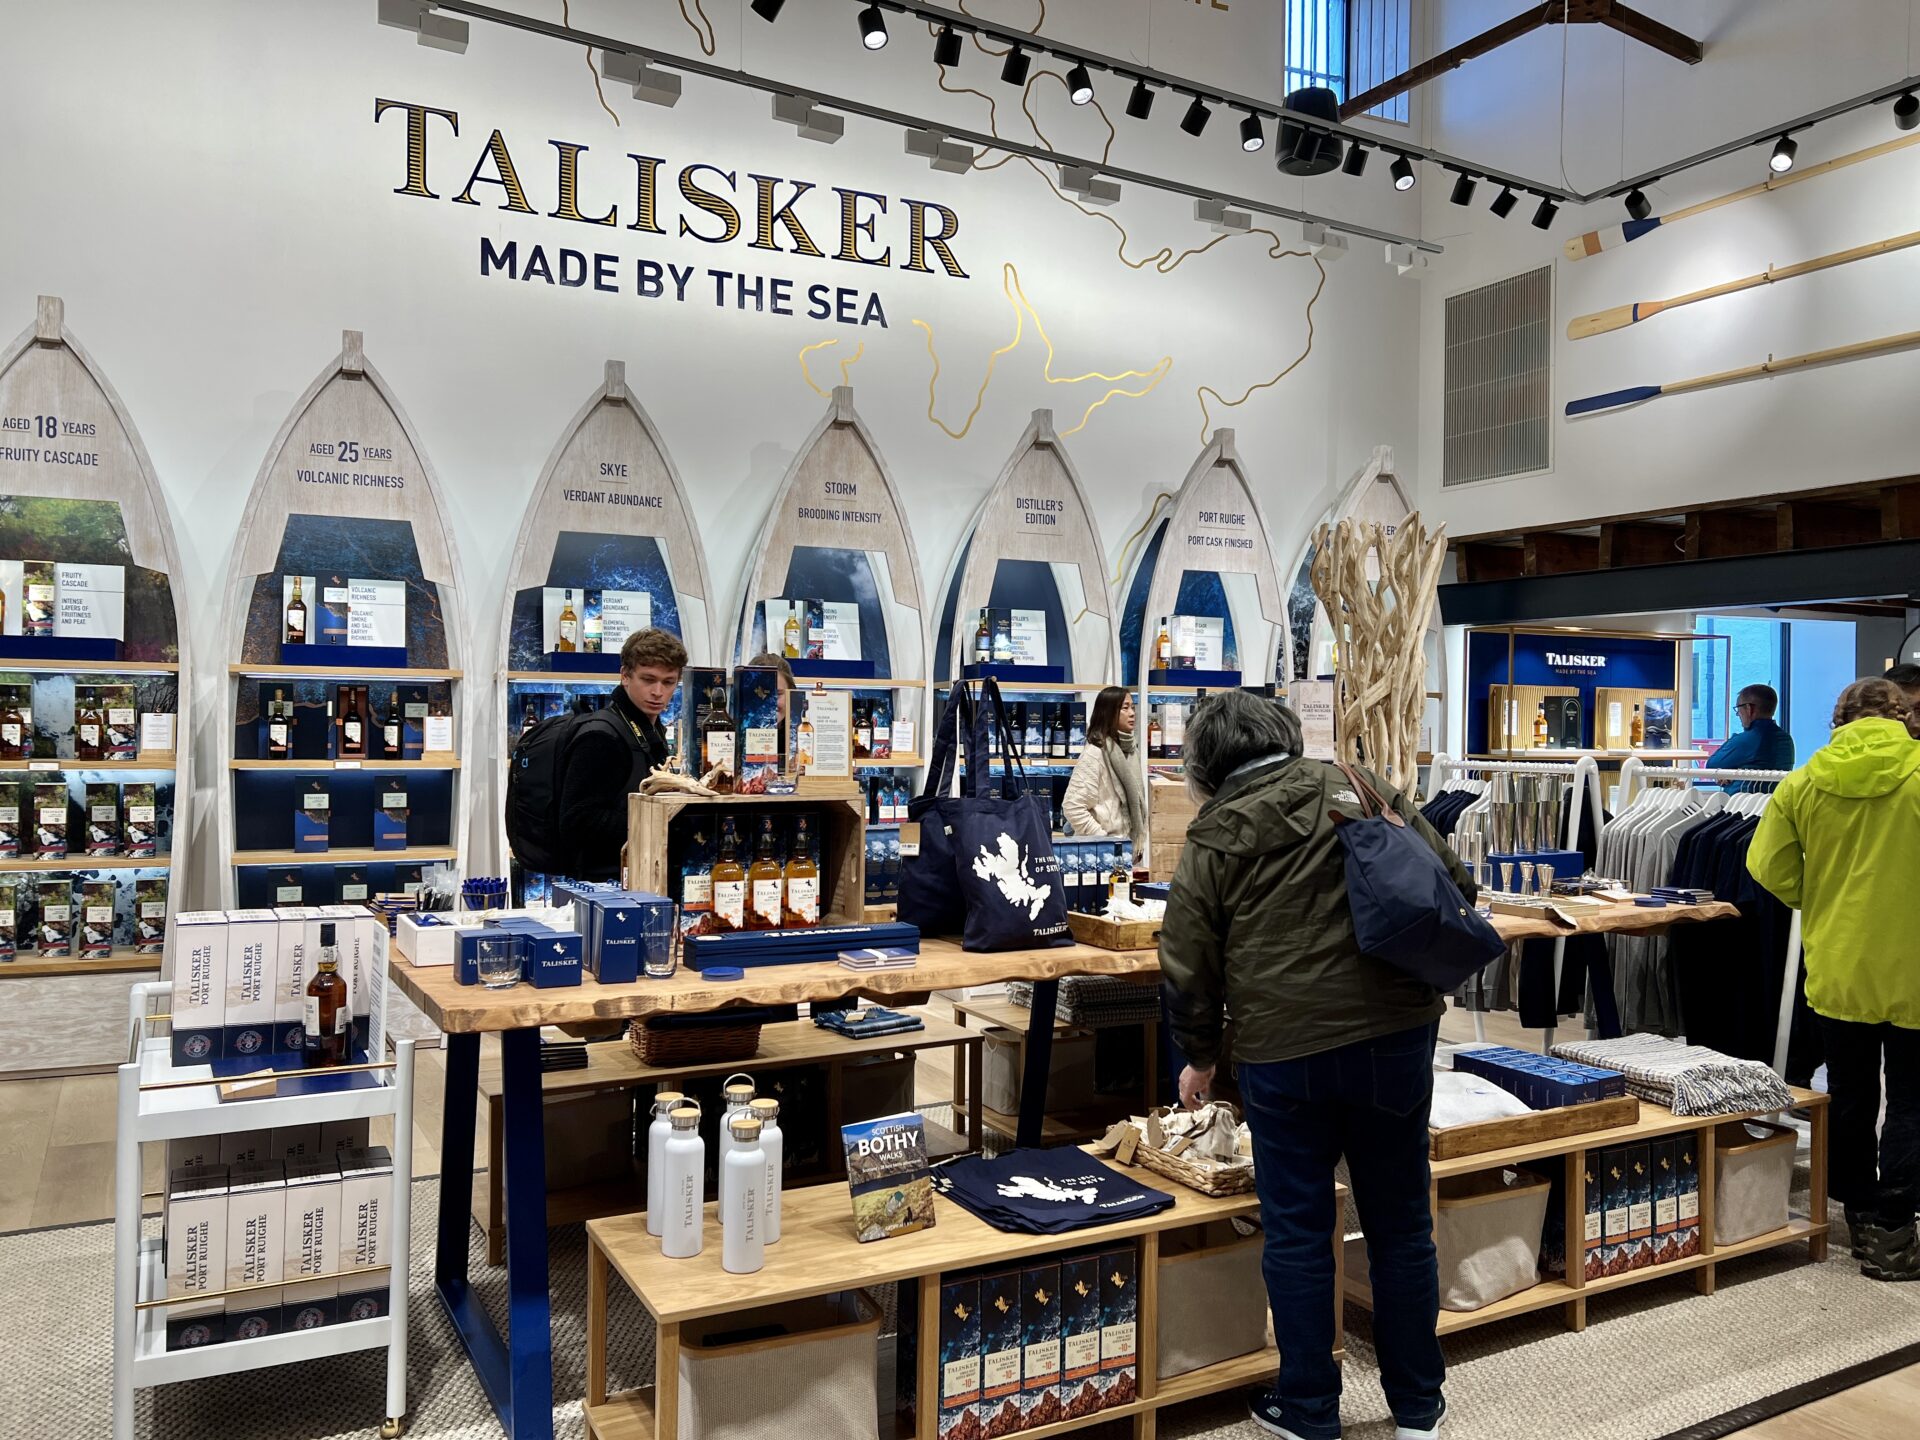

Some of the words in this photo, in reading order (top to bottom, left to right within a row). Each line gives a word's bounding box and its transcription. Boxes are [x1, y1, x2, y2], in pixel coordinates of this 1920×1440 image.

[374, 97, 970, 279] TALISKER
[480, 237, 619, 293] MADE
[636, 259, 695, 302] BY
[707, 271, 794, 316] THE
[806, 285, 889, 329] SEA
[2, 417, 31, 430] AGED
[34, 415, 58, 439] 18
[62, 421, 96, 436] YEARS
[43, 450, 99, 466] CASCADE
[309, 443, 334, 455] AGED
[337, 440, 359, 463] 25
[363, 447, 392, 460] YEARS
[297, 469, 350, 485] VOLCANIC
[352, 474, 404, 489] RICHNESS
[600, 462, 628, 477] SKYE
[563, 489, 605, 504] VERDANT
[607, 492, 663, 508] ABUNDANCE
[825, 481, 857, 496] STORM
[798, 507, 840, 521] BROODING
[842, 511, 882, 524] INTENSITY
[1016, 497, 1064, 512] DISTILLER'S
[1025, 513, 1056, 526] EDITION
[1199, 511, 1218, 523] PORT
[1219, 513, 1246, 526] RUIGHE
[1187, 535, 1205, 546] PORT
[1205, 537, 1223, 548] CASK
[1224, 538, 1253, 549] FINISHED
[61, 580, 88, 588] CASCADE
[351, 586, 377, 594] VOLCANIC
[1546, 652, 1606, 667] TALISKER
[1033, 925, 1069, 936] TALISKER
[200, 945, 211, 978] RUIGHE
[253, 942, 262, 975] RUIGHE
[291, 944, 303, 997] TALISKER
[541, 959, 579, 968] TALISKER
[189, 948, 202, 1004] TALISKER
[241, 946, 253, 1000] TALISKER
[200, 979, 209, 1005] PORT
[252, 976, 260, 1001] PORT
[871, 1124, 905, 1136] SCOTTISH
[858, 1130, 919, 1157] BOTHY
[879, 1151, 903, 1161] WALKS
[684, 1175, 694, 1228] TALISKER
[765, 1163, 775, 1216] TALISKER
[315, 1207, 324, 1245] RUIGHE
[369, 1198, 378, 1236] RUIGHE
[745, 1188, 755, 1243] TALISKER
[200, 1221, 209, 1259] RUIGHE
[258, 1214, 267, 1253] RUIGHE
[301, 1211, 314, 1274] TALISKER
[355, 1203, 368, 1264] TALISKER
[185, 1225, 198, 1289] TALISKER
[243, 1218, 257, 1283] TALISKER
[314, 1247, 322, 1274] PORT
[368, 1238, 376, 1265] PORT
[199, 1261, 207, 1290] PORT
[257, 1254, 265, 1283] PORT
[1068, 1336, 1098, 1348] TALISKER
[1104, 1327, 1134, 1338] TALISKER
[988, 1353, 1019, 1365] TALISKER
[1028, 1345, 1058, 1357] TALISKER
[947, 1361, 978, 1374] TALISKER
